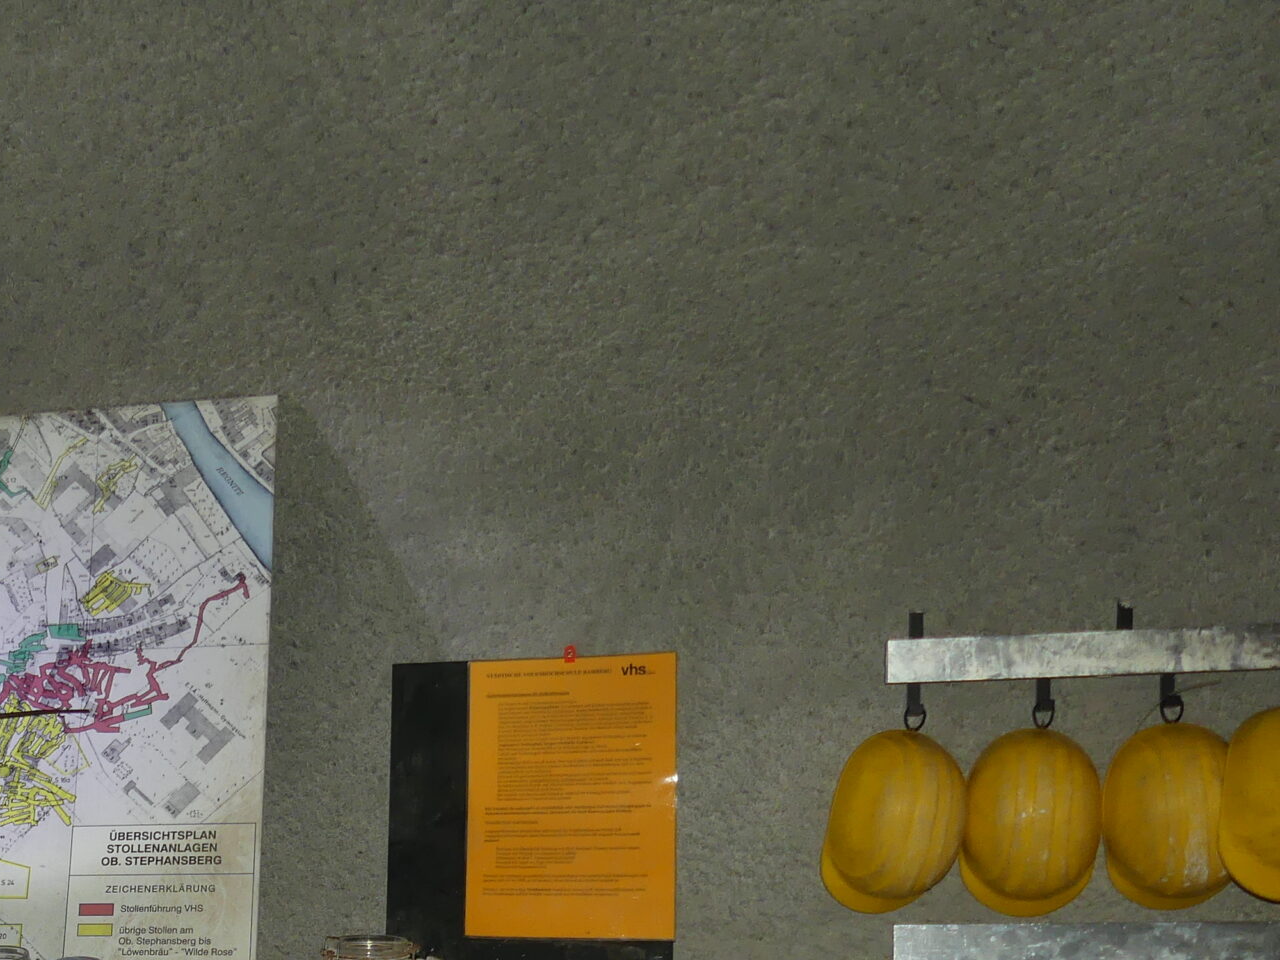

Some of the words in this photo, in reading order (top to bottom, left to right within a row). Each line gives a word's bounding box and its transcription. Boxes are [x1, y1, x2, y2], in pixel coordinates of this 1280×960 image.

[620, 662, 647, 676] vhs
[109, 829, 217, 841] ÜBERSICHTSPLAN
[106, 842, 218, 854] STOLLENANLAGEN
[101, 856, 121, 866] OB.
[125, 855, 222, 866] STEPHANSBERG
[105, 883, 216, 894] ZEICHENERKLÄRUNG
[120, 904, 182, 914] Stollenführung
[184, 904, 204, 913] VHS
[119, 926, 147, 936] übrige
[148, 926, 178, 934] Stollen
[118, 937, 134, 946] Ob.
[136, 937, 196, 947] Stephansberg
[198, 937, 212, 945] bis
[118, 948, 173, 956] "Löwenbräu"
[181, 948, 209, 956] "Wilde
[210, 948, 238, 956] Rose"
